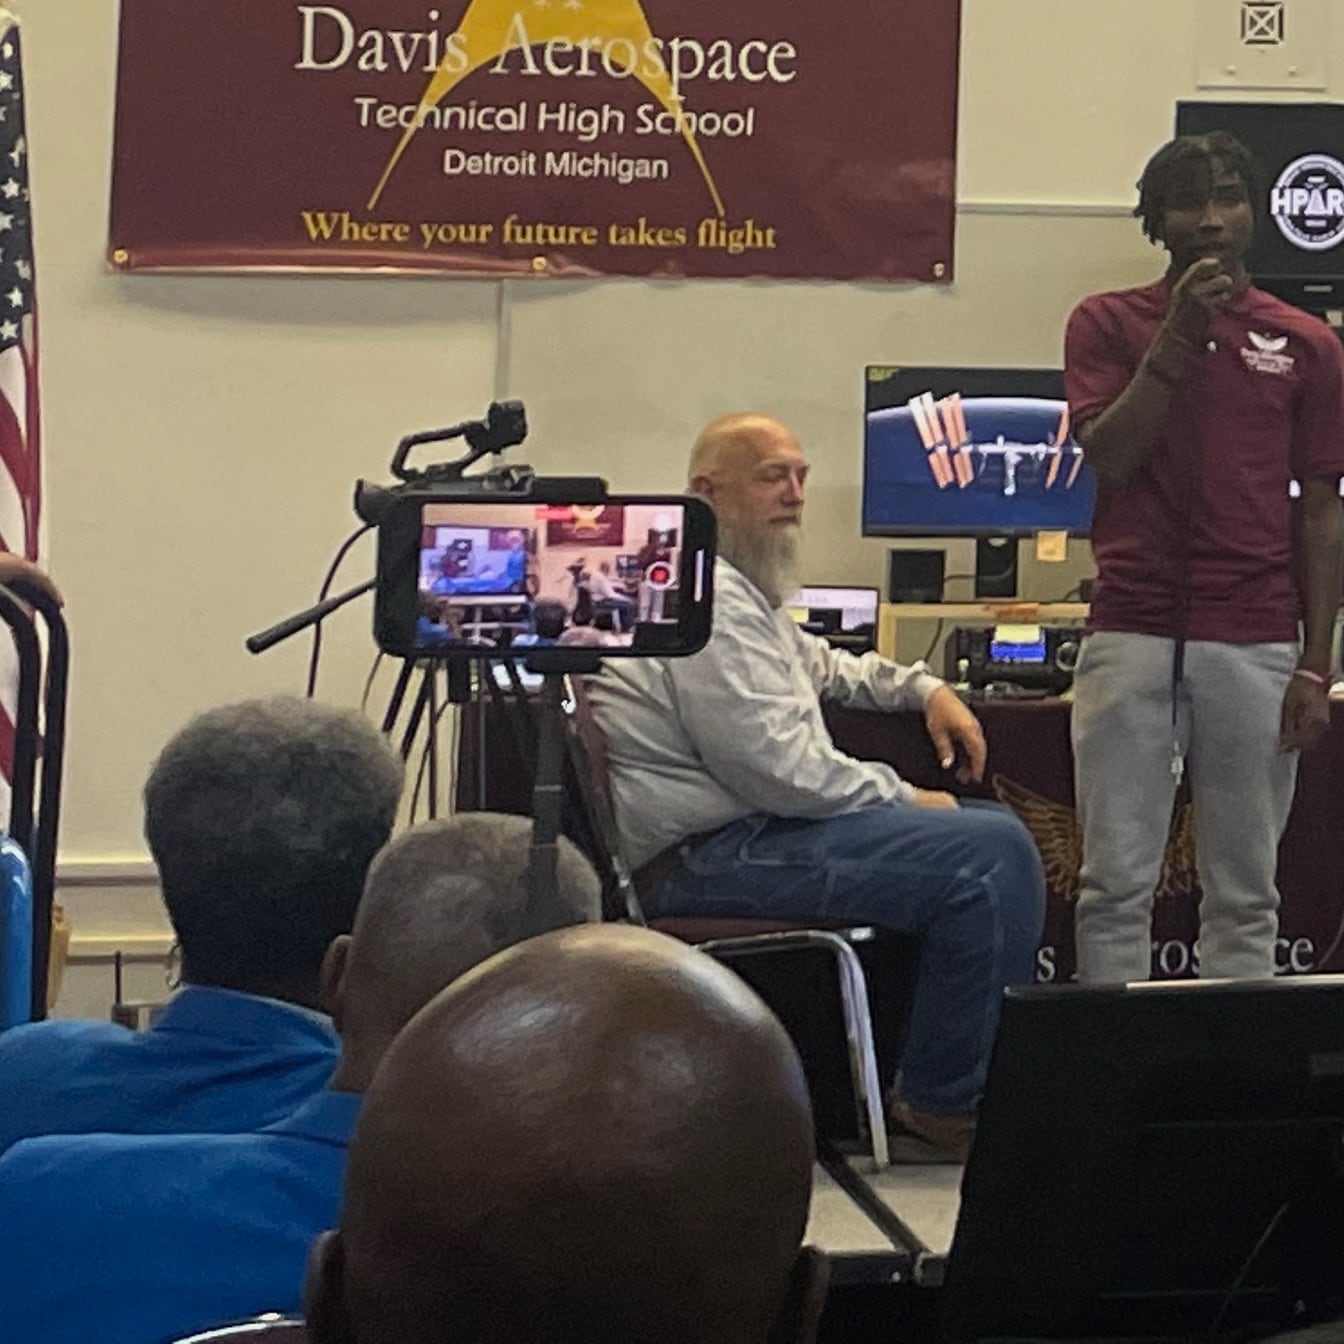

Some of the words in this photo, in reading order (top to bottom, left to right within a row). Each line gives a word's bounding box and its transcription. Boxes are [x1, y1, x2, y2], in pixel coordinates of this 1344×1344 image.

[294, 6, 469, 73] Davis
[489, 12, 797, 101] Aerospace
[354, 97, 526, 131] Technical
[537, 102, 625, 141] High
[635, 103, 755, 137] School
[444, 149, 536, 176] Detroit
[545, 152, 669, 184] Michigan
[301, 210, 411, 242] Where
[420, 222, 494, 249] your
[503, 214, 598, 245] future
[608, 217, 687, 247] takes
[698, 218, 777, 254] flight
